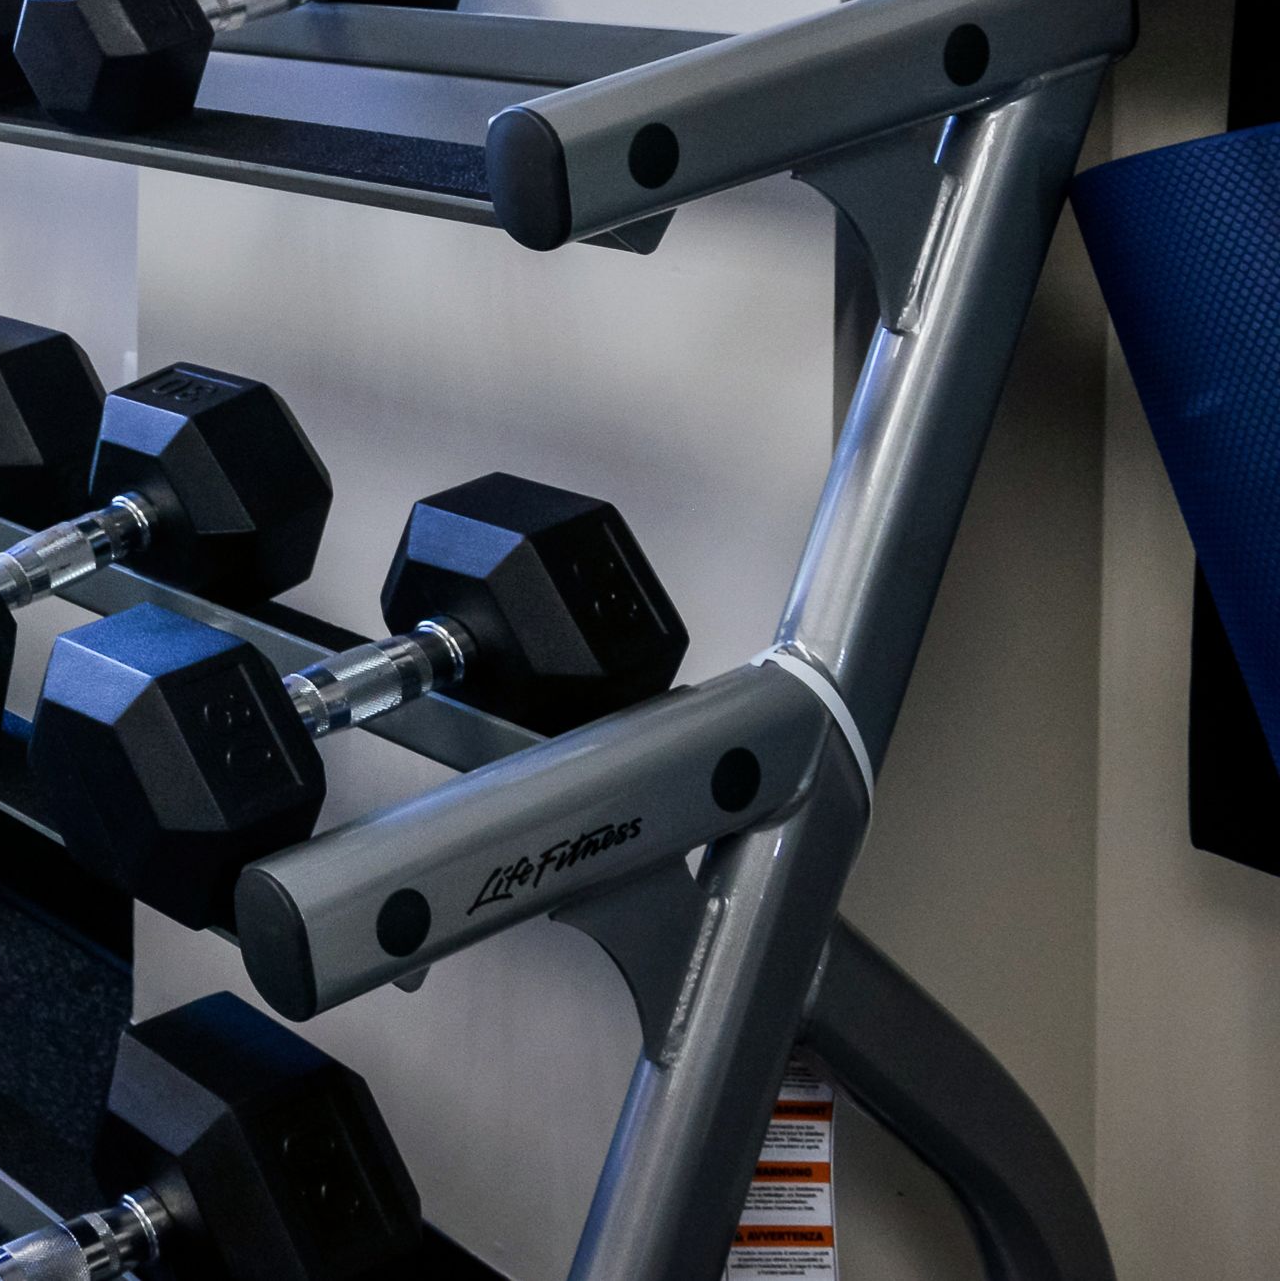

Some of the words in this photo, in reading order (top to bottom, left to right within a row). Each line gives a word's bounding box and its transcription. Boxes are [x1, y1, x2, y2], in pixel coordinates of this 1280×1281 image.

[466, 856, 535, 916] Life
[533, 817, 643, 889] Fitness
[747, 1230, 825, 1242] AVVERTENZA
